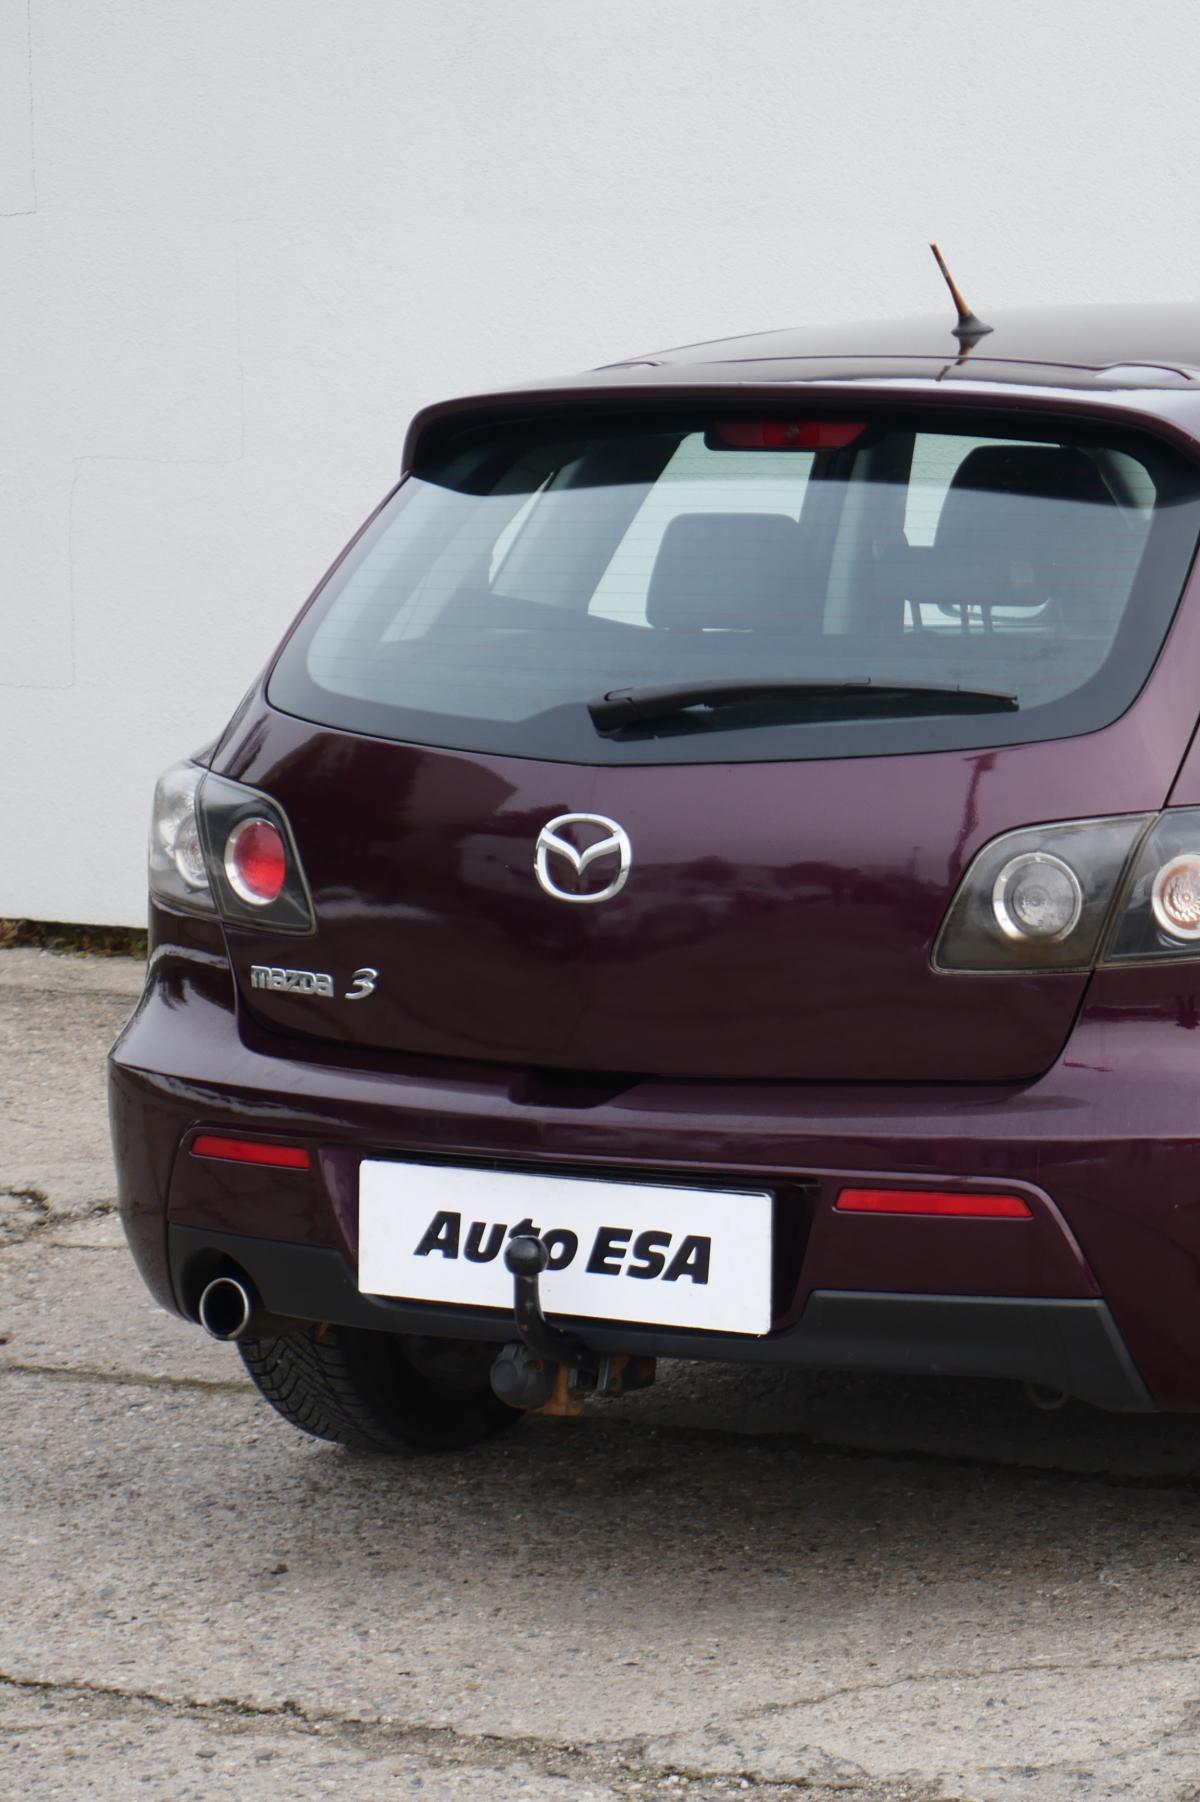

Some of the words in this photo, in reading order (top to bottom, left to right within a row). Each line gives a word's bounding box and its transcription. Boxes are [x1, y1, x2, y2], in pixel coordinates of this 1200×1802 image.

[344, 968, 378, 999] 3
[413, 1210, 579, 1271] Auo
[585, 1226, 712, 1285] ESA
